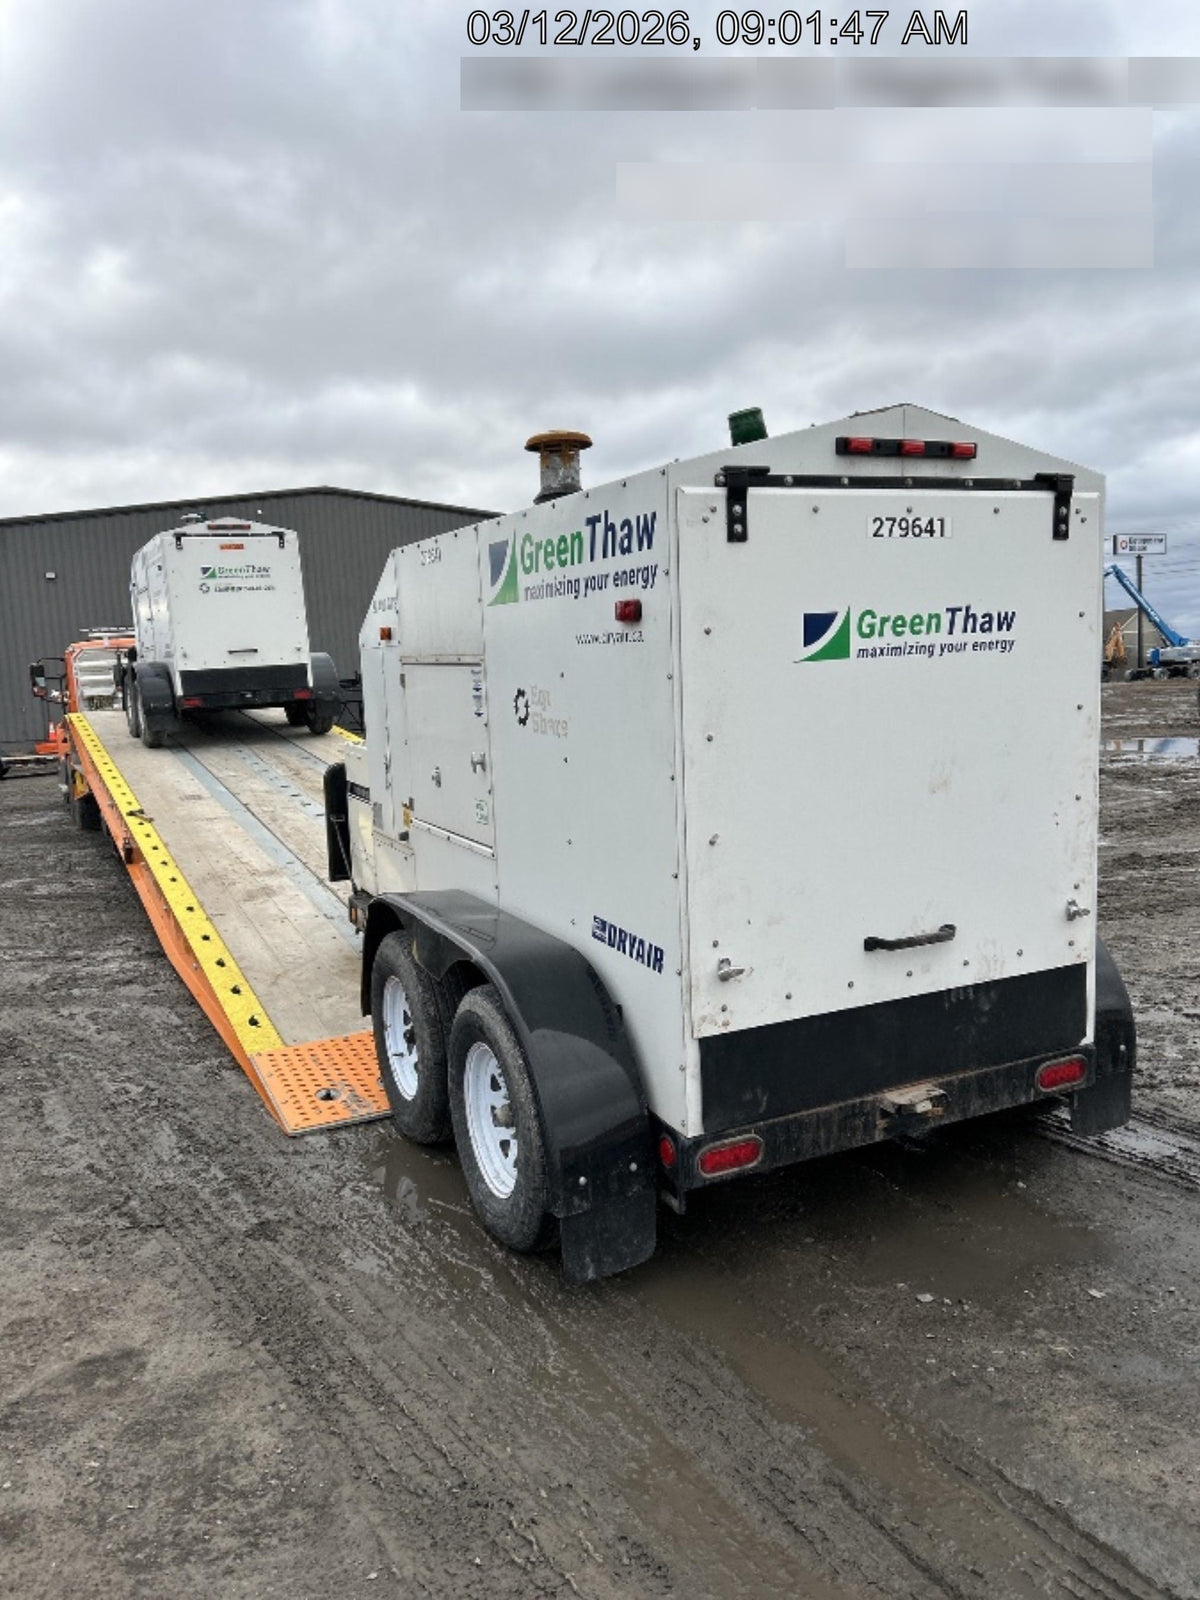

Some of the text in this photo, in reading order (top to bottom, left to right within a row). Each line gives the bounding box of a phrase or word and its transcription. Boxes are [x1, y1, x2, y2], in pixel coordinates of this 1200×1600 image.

[520, 510, 657, 575] GreenThaw
[873, 517, 945, 537] 279641
[524, 563, 659, 602] maximizing your energy
[857, 605, 1016, 639] GreenThaw
[856, 638, 1016, 660] maximizing your energy
[607, 923, 665, 975] DRYAIR
